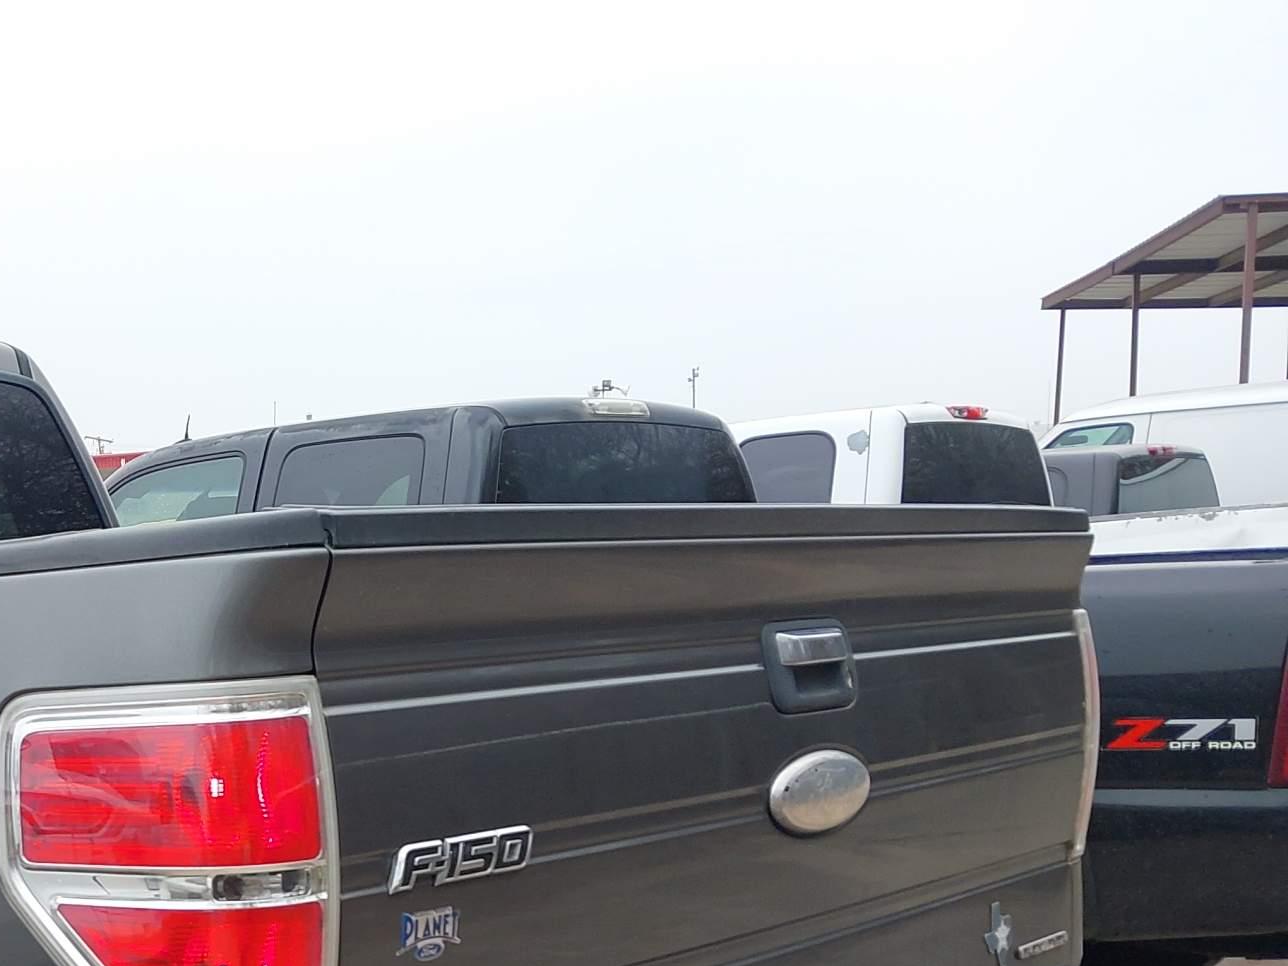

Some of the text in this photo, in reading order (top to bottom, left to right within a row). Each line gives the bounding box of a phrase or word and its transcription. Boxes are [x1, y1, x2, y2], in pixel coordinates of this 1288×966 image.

[1106, 717, 1257, 750] Z71
[1169, 741, 1256, 750] OFF ROAD
[388, 824, 533, 895] F-150
[401, 907, 461, 948] PLANET
